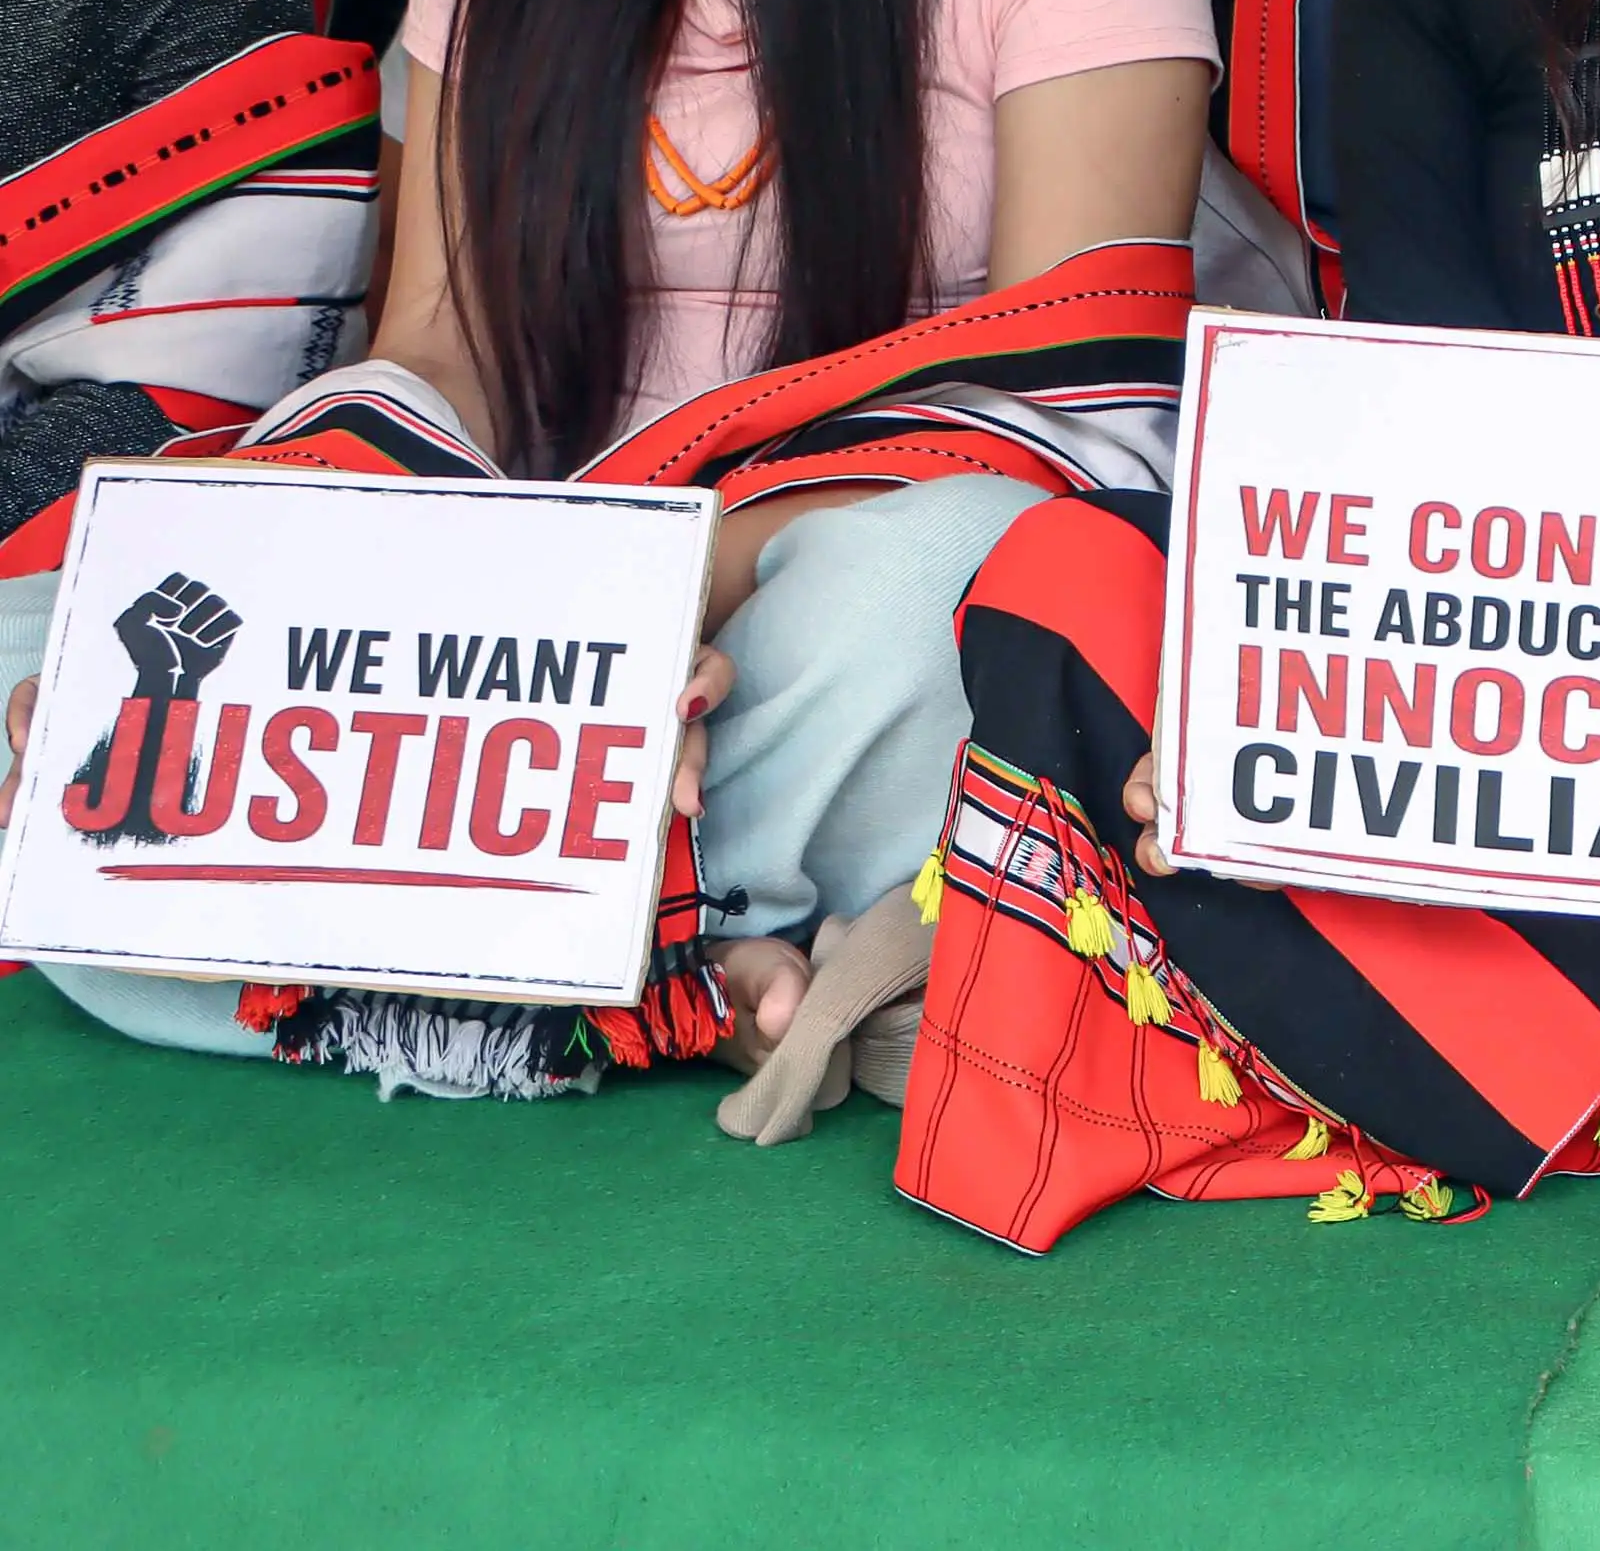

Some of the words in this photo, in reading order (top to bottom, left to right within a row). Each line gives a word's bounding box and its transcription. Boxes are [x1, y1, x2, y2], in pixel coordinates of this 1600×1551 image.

[1239, 485, 1373, 566] WE
[1236, 574, 1351, 638] THE
[287, 626, 391, 694] WE
[418, 633, 627, 707] WANT
[61, 696, 646, 861] JUSTICE
